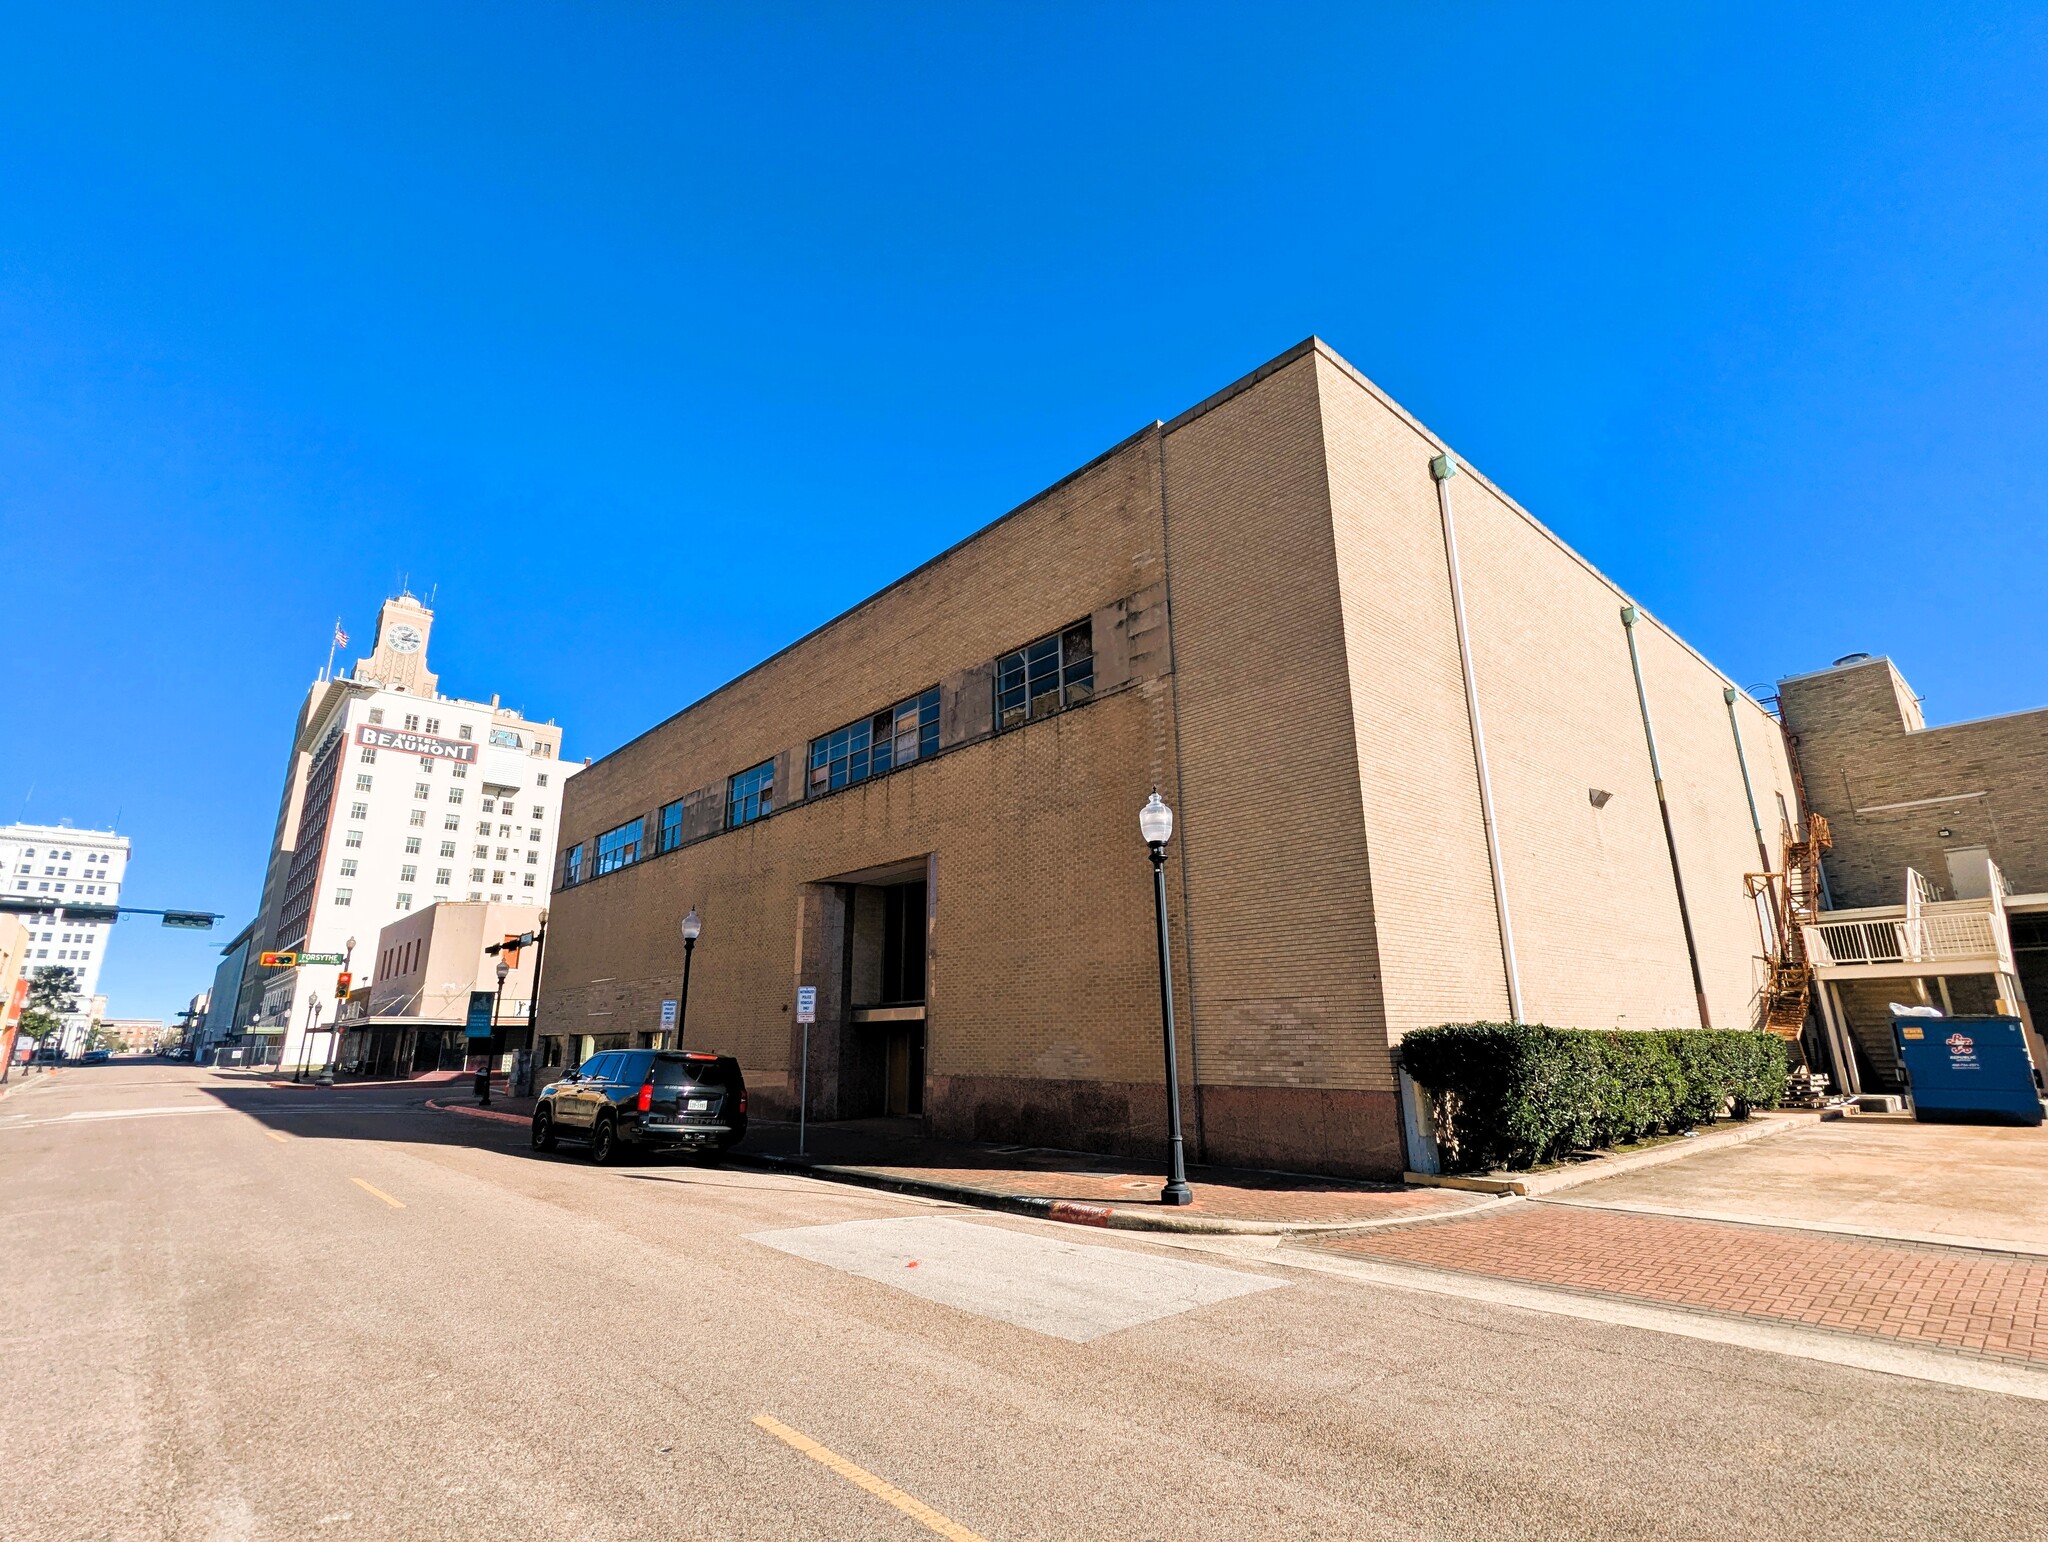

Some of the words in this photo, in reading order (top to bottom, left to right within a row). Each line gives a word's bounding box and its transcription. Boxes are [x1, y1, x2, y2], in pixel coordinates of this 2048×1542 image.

[361, 728, 472, 760] BEAUMONT
[397, 733, 439, 746] HOTEL
[301, 953, 339, 962] FORSYTHE
[656, 1117, 705, 1125] BEAUMONT
